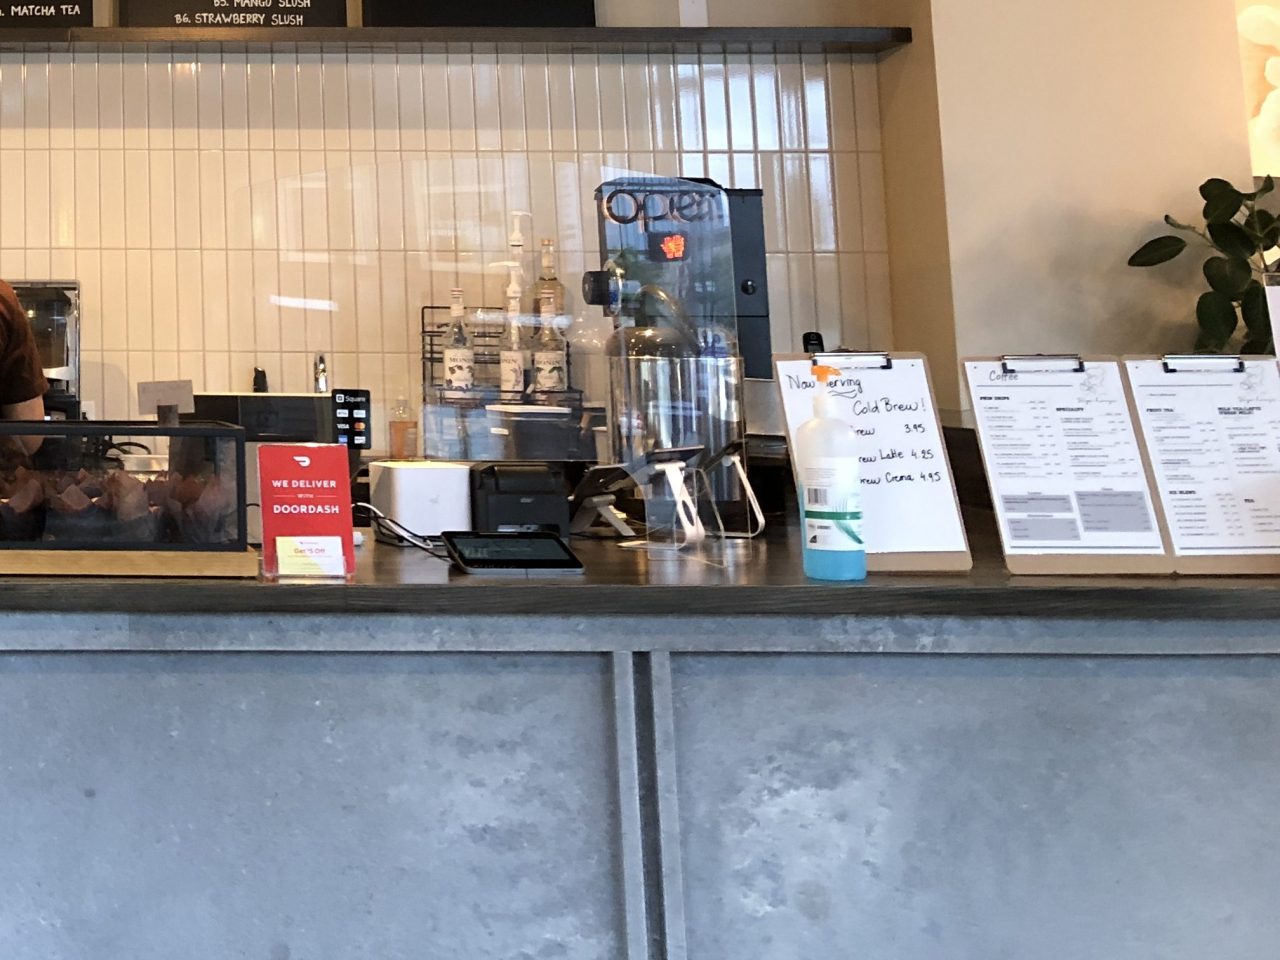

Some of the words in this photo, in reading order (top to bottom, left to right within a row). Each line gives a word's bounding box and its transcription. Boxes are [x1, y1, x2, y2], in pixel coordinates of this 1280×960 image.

[11, 5, 55, 16] MATCHA
[60, 5, 80, 14] TEA
[174, 13, 191, 24] B6.
[195, 13, 265, 24] STRAWBERRY
[271, 14, 303, 25] SLUSH
[826, 379, 863, 394] erving
[852, 400, 880, 416] Cold
[855, 427, 875, 436] rew
[904, 423, 926, 433] 3.95
[911, 448, 935, 460] 4.25
[920, 471, 942, 483] 4.95
[271, 479, 289, 488] WE
[291, 479, 337, 488] DELIVER
[273, 504, 340, 514] DOORDASH
